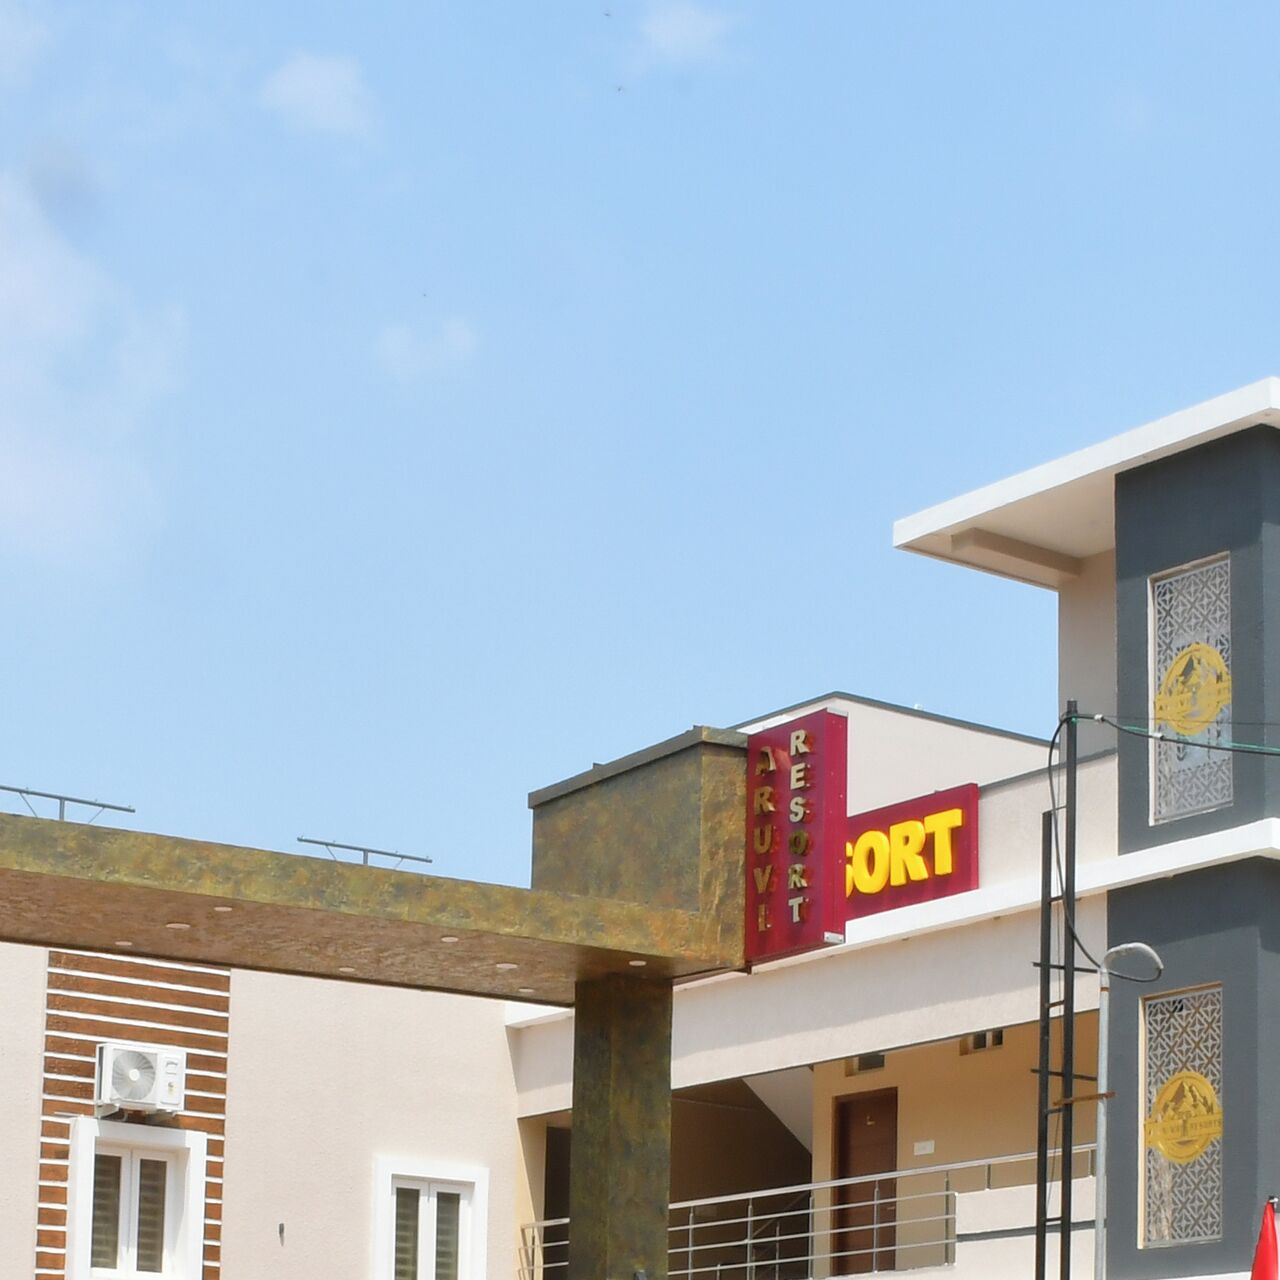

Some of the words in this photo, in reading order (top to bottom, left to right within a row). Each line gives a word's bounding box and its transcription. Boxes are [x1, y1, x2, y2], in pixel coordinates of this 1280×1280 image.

[754, 746, 777, 932] ARUVI
[788, 729, 811, 923] RESORT
[846, 808, 962, 898] ORT
